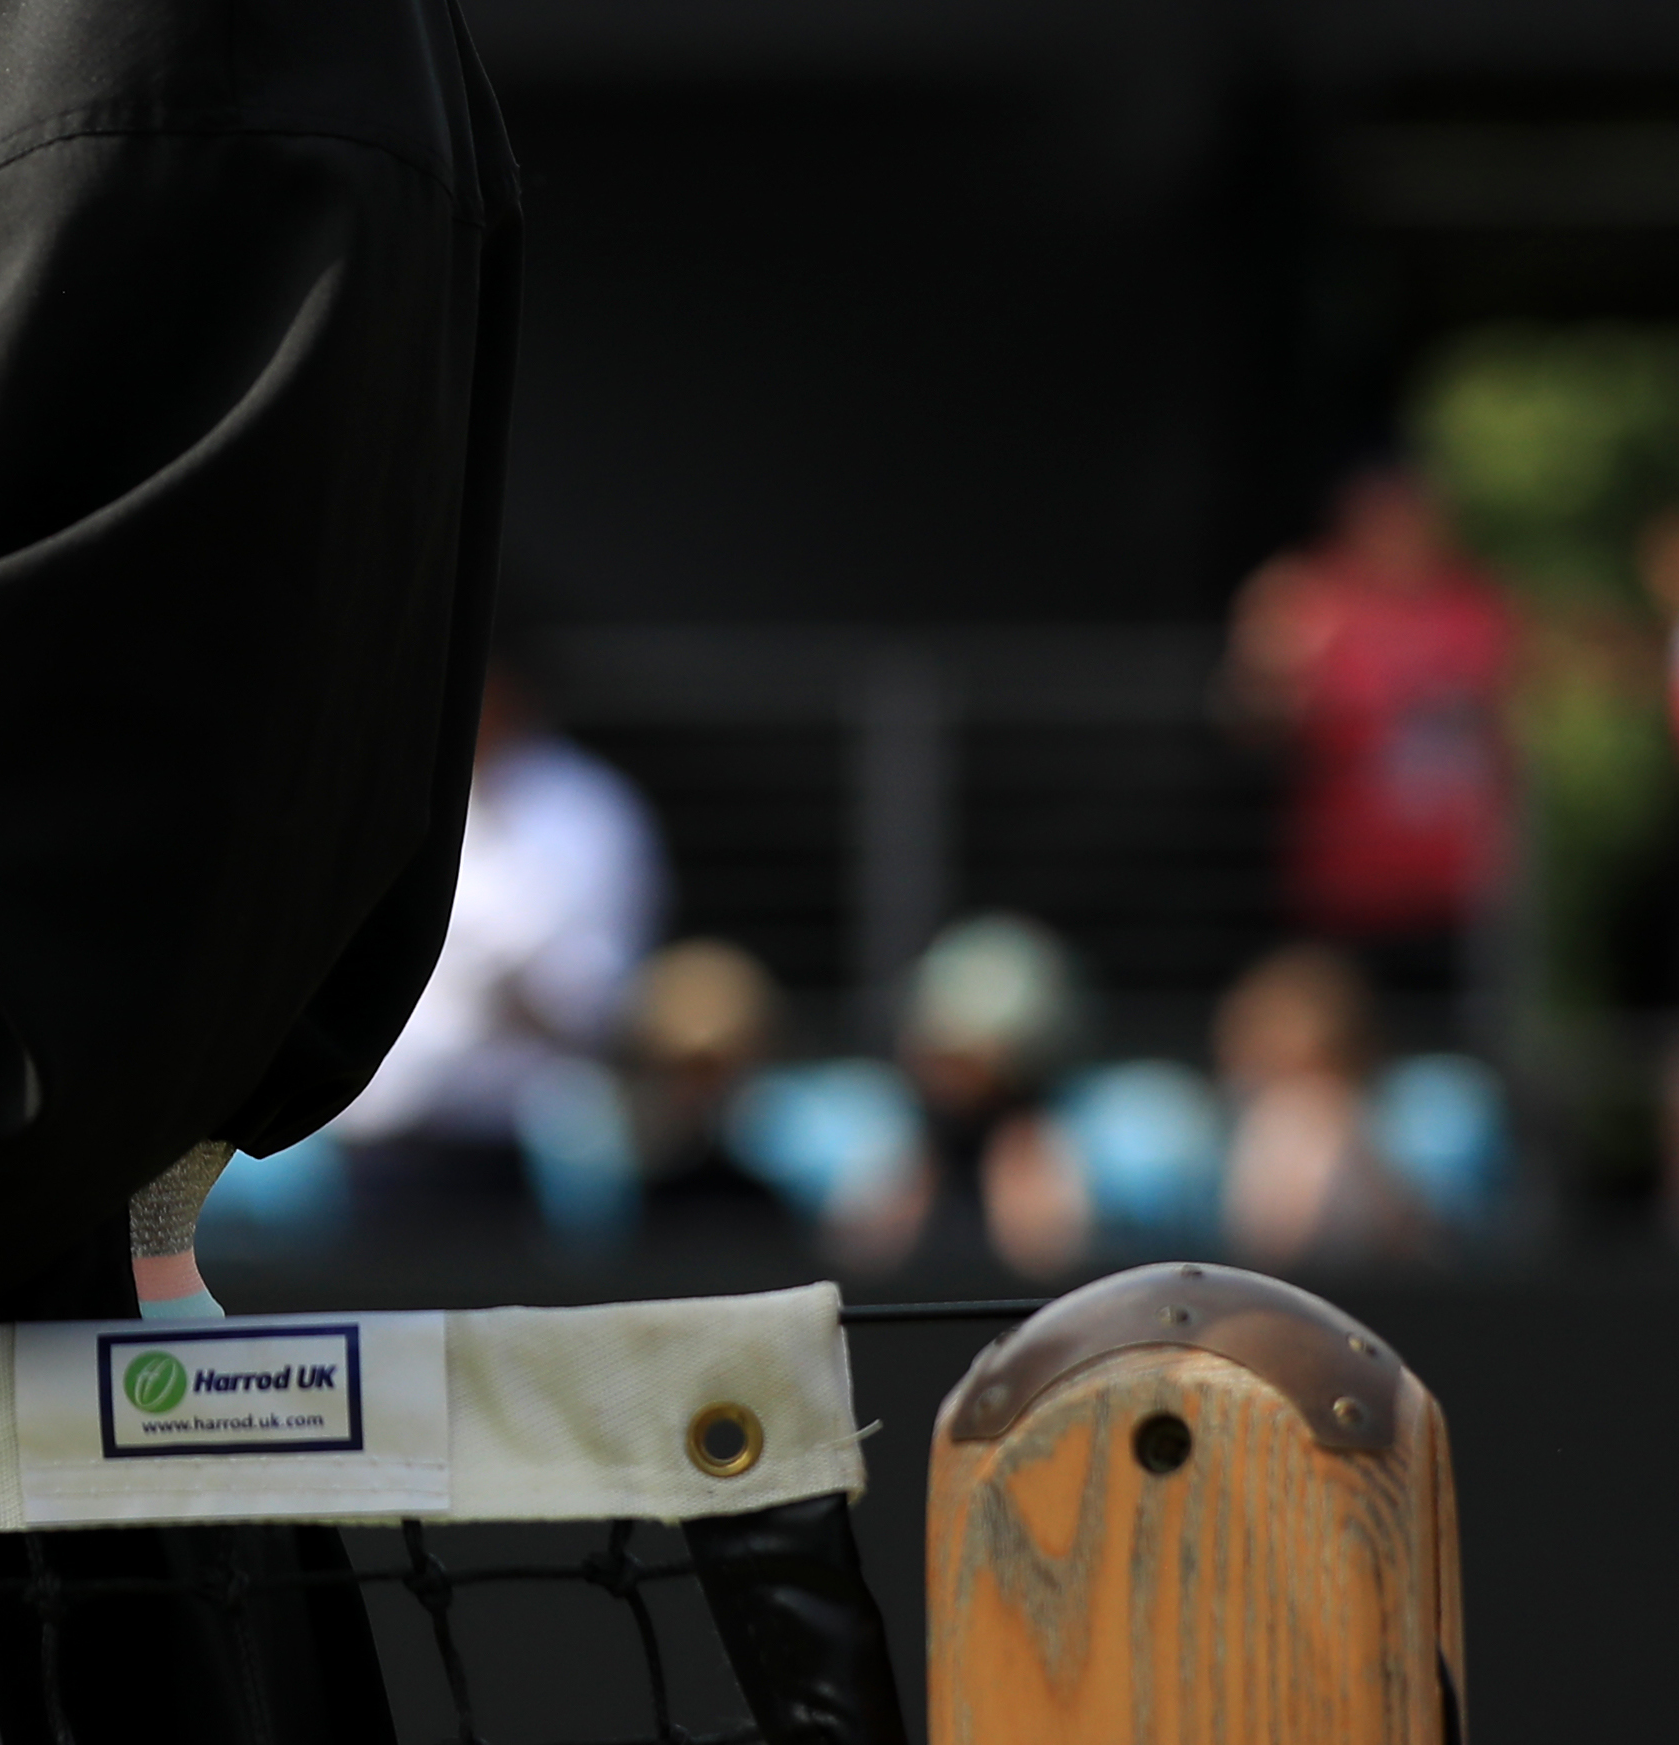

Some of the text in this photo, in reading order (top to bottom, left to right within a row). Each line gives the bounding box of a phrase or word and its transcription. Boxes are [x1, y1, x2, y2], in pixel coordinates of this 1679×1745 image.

[192, 1364, 337, 1394] Harrod UK
[141, 1413, 325, 1435] www.harrod.uk.com
